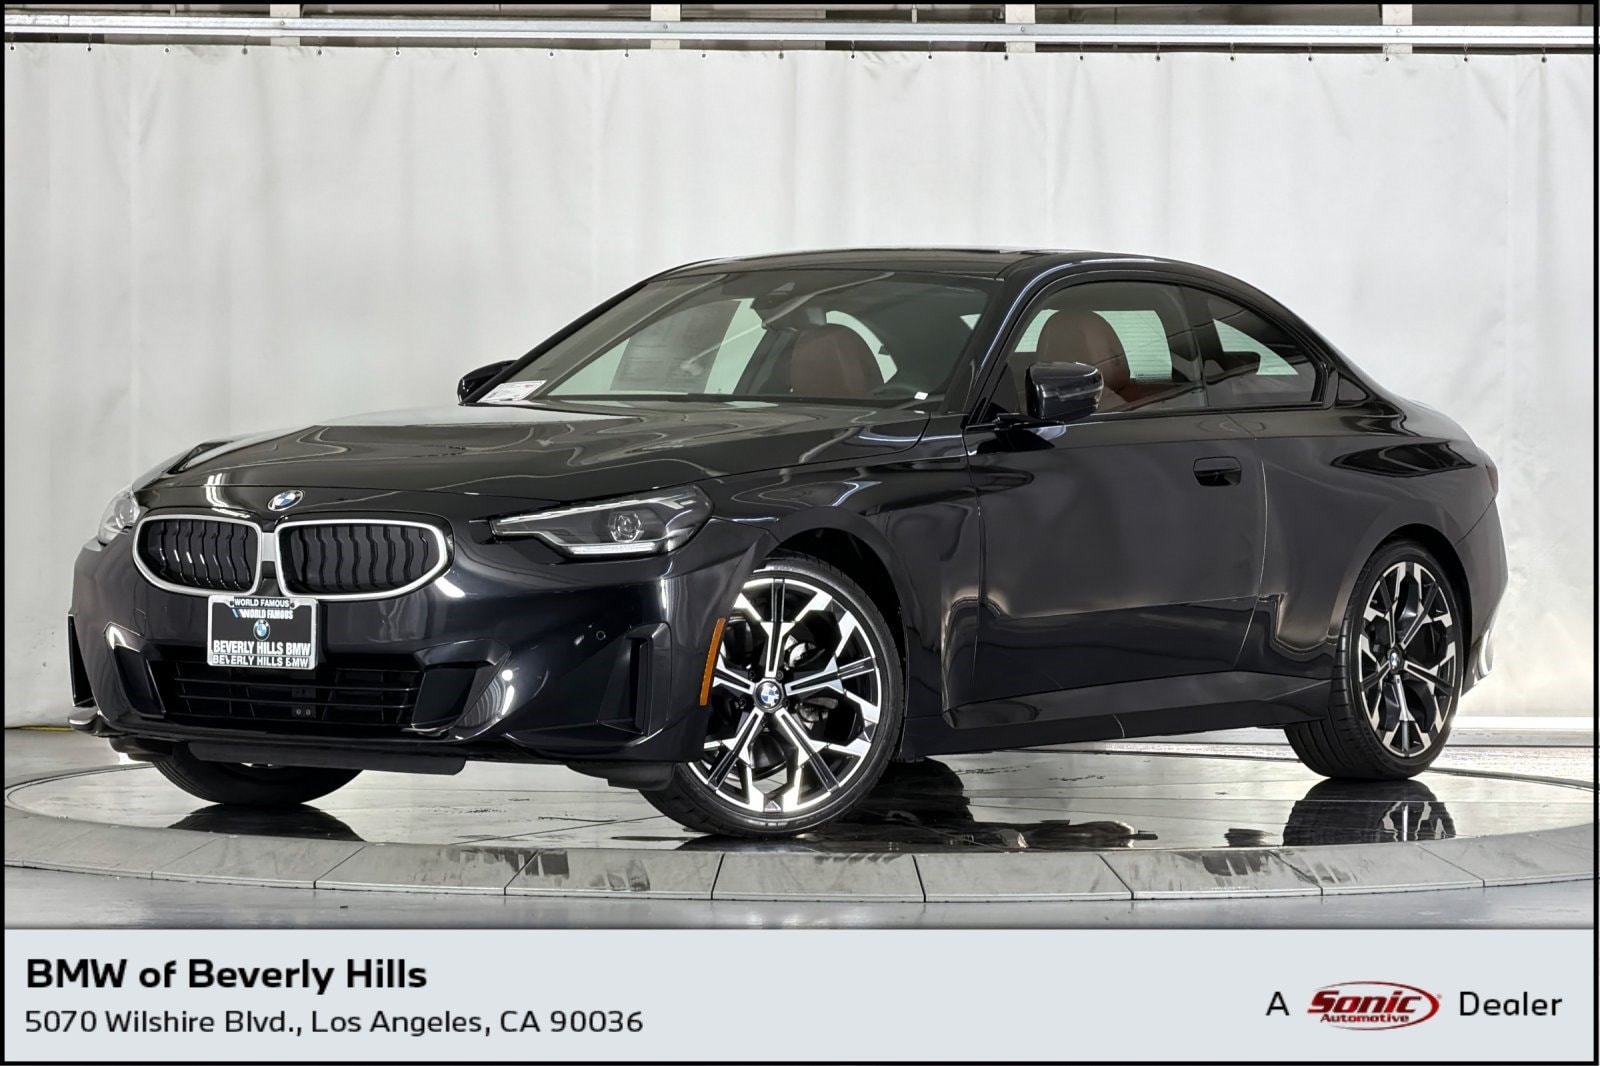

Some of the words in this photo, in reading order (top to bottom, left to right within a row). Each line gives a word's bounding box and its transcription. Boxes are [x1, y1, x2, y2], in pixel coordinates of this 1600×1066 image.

[234, 598, 259, 607] WORLD
[260, 599, 290, 608] FAMOUS
[240, 608, 267, 619] WORLD
[267, 609, 294, 620] FAMOUS
[213, 640, 255, 654] BEVERLY
[256, 641, 284, 655] HILLS
[285, 642, 311, 656] BMW
[213, 654, 254, 666] BEVERLY
[256, 655, 283, 667] HILLS
